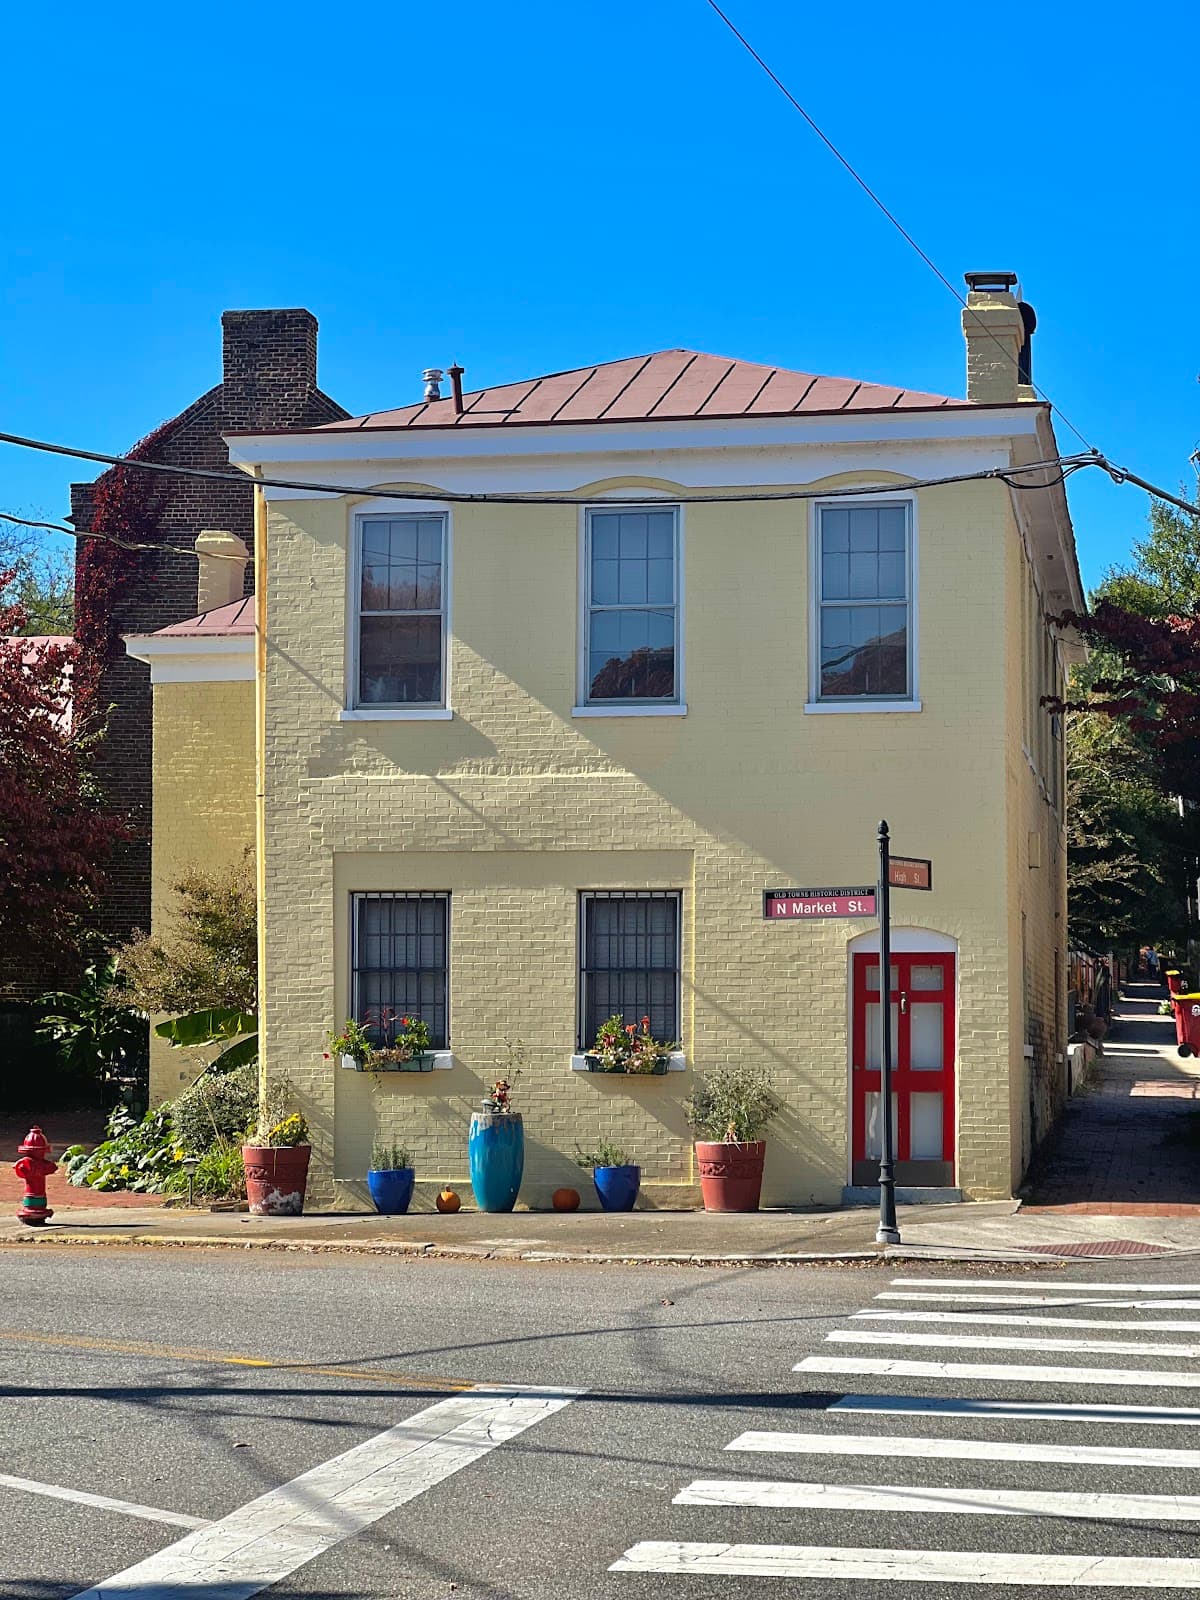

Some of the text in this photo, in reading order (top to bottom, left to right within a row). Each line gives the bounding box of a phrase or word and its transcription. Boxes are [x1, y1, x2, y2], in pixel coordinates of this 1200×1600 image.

[894, 871, 907, 884] High
[777, 900, 867, 914] N Market St.
